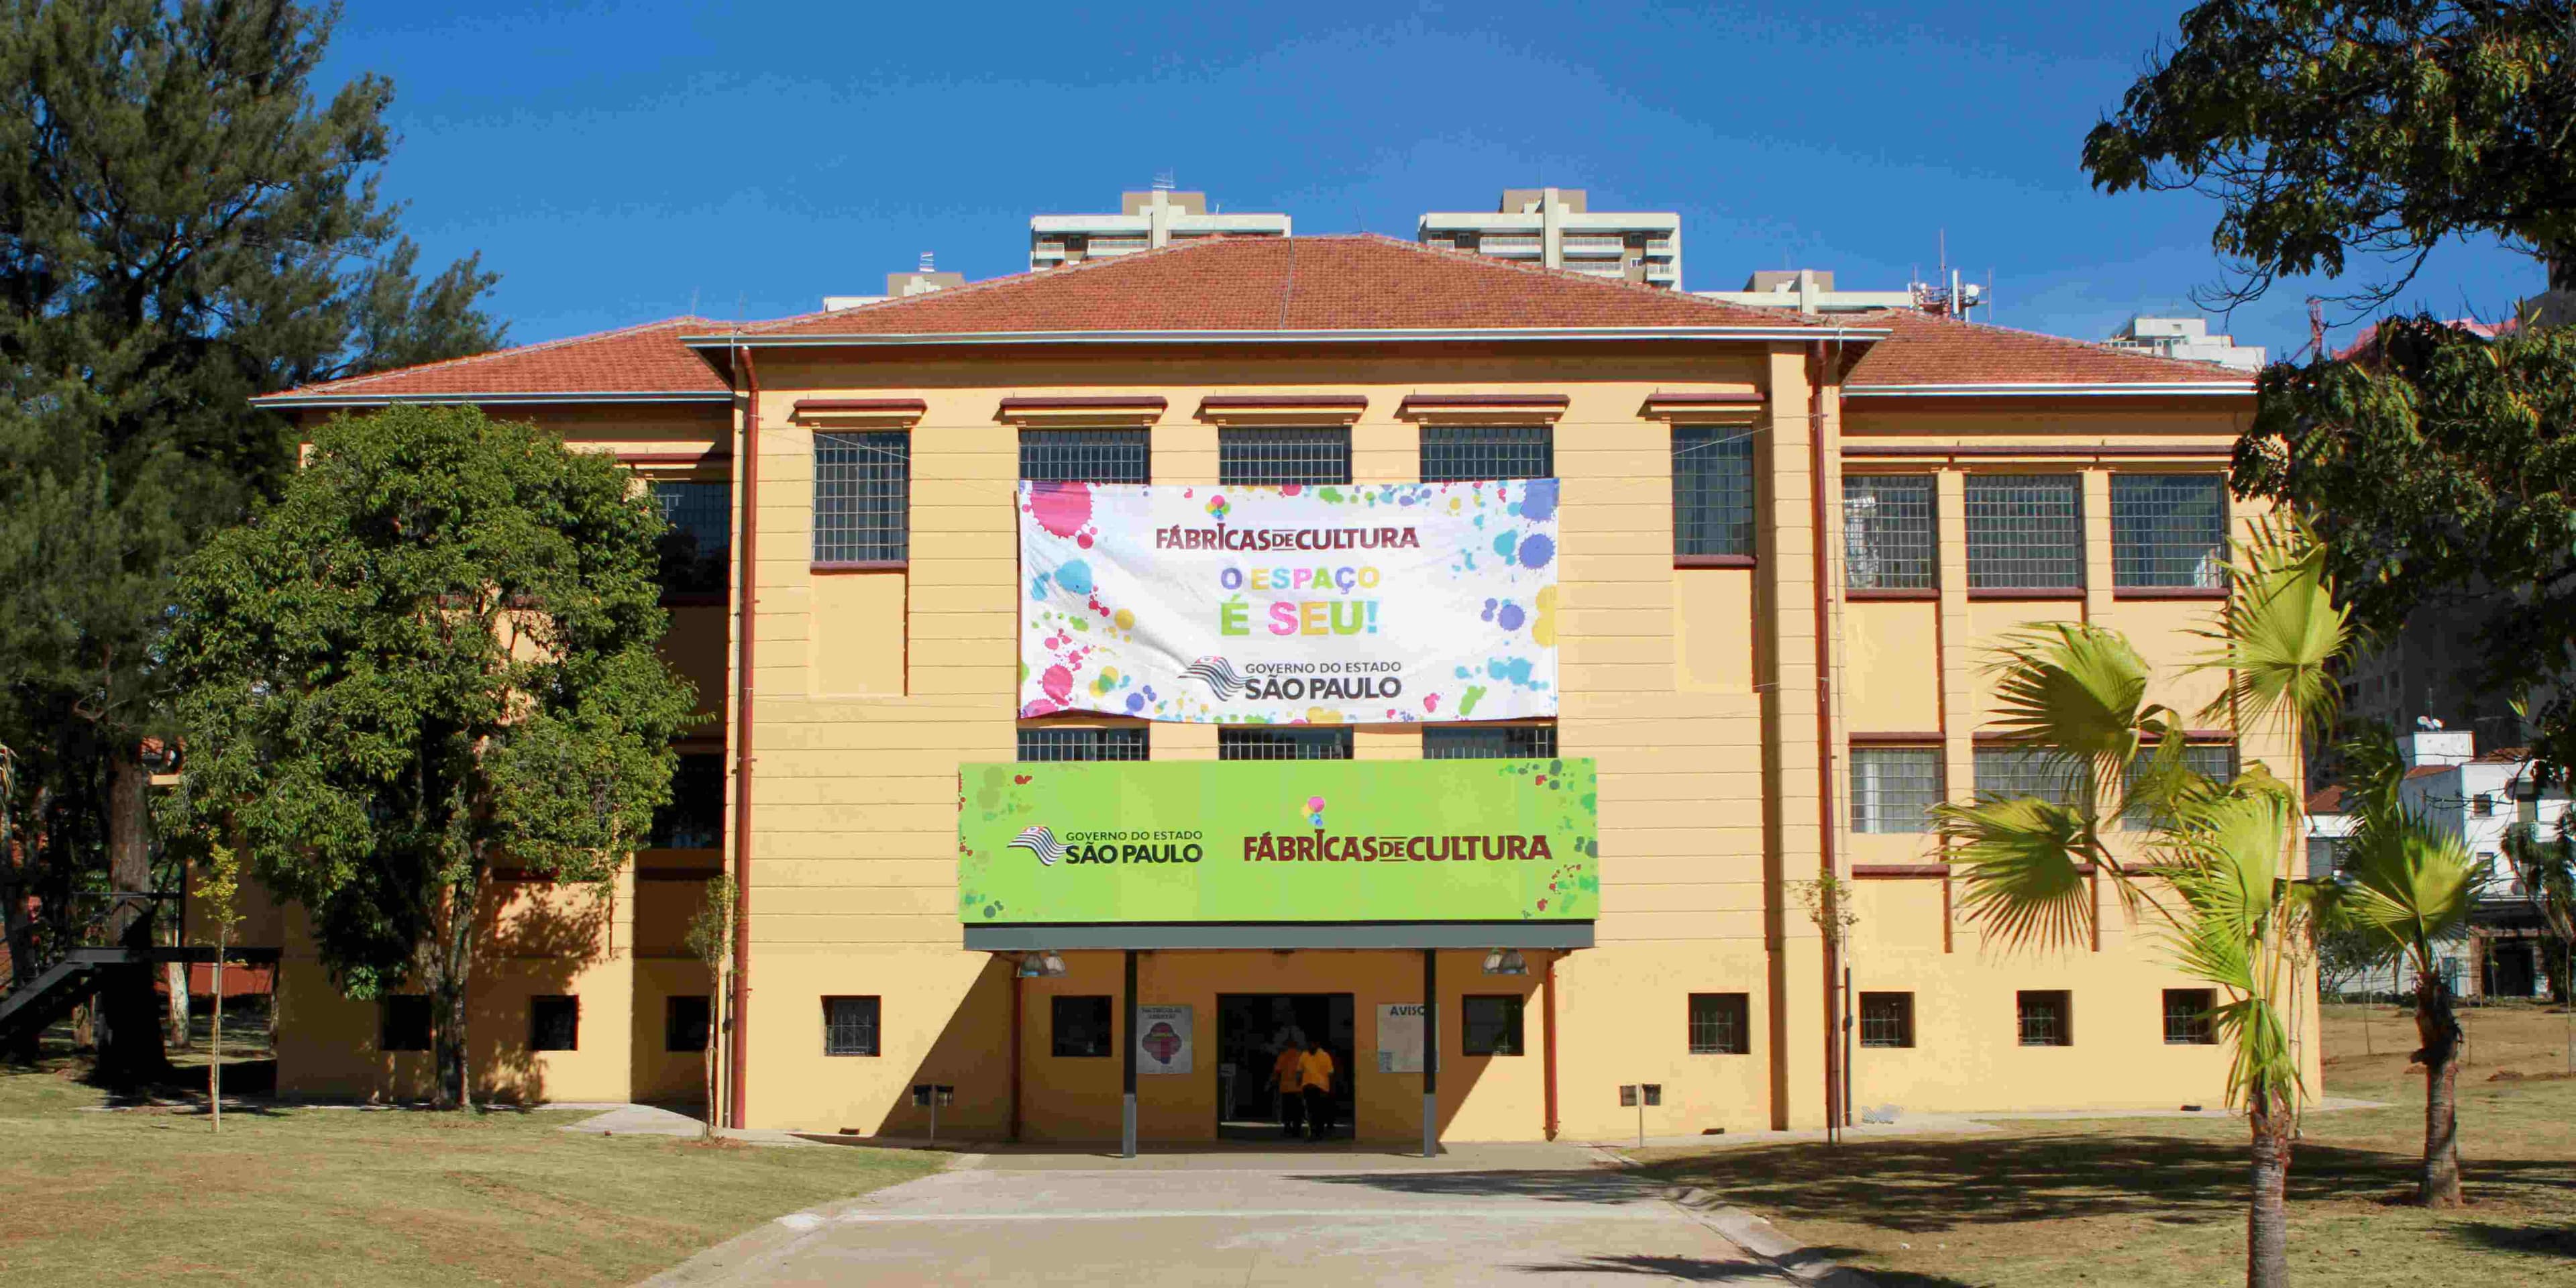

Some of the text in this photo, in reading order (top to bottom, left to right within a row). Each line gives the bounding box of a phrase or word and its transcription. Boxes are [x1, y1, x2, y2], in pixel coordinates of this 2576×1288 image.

[1220, 566, 1380, 594] O ESPAÇO
[1220, 594, 1378, 636] É SEU!
[1245, 661, 1401, 674] GOVERNO DO ESTADO
[1244, 674, 1401, 700] SÃO PAULO
[1065, 830, 1203, 841] GOVERNO DO ESTADO
[1065, 841, 1203, 864] SÃO PAULO
